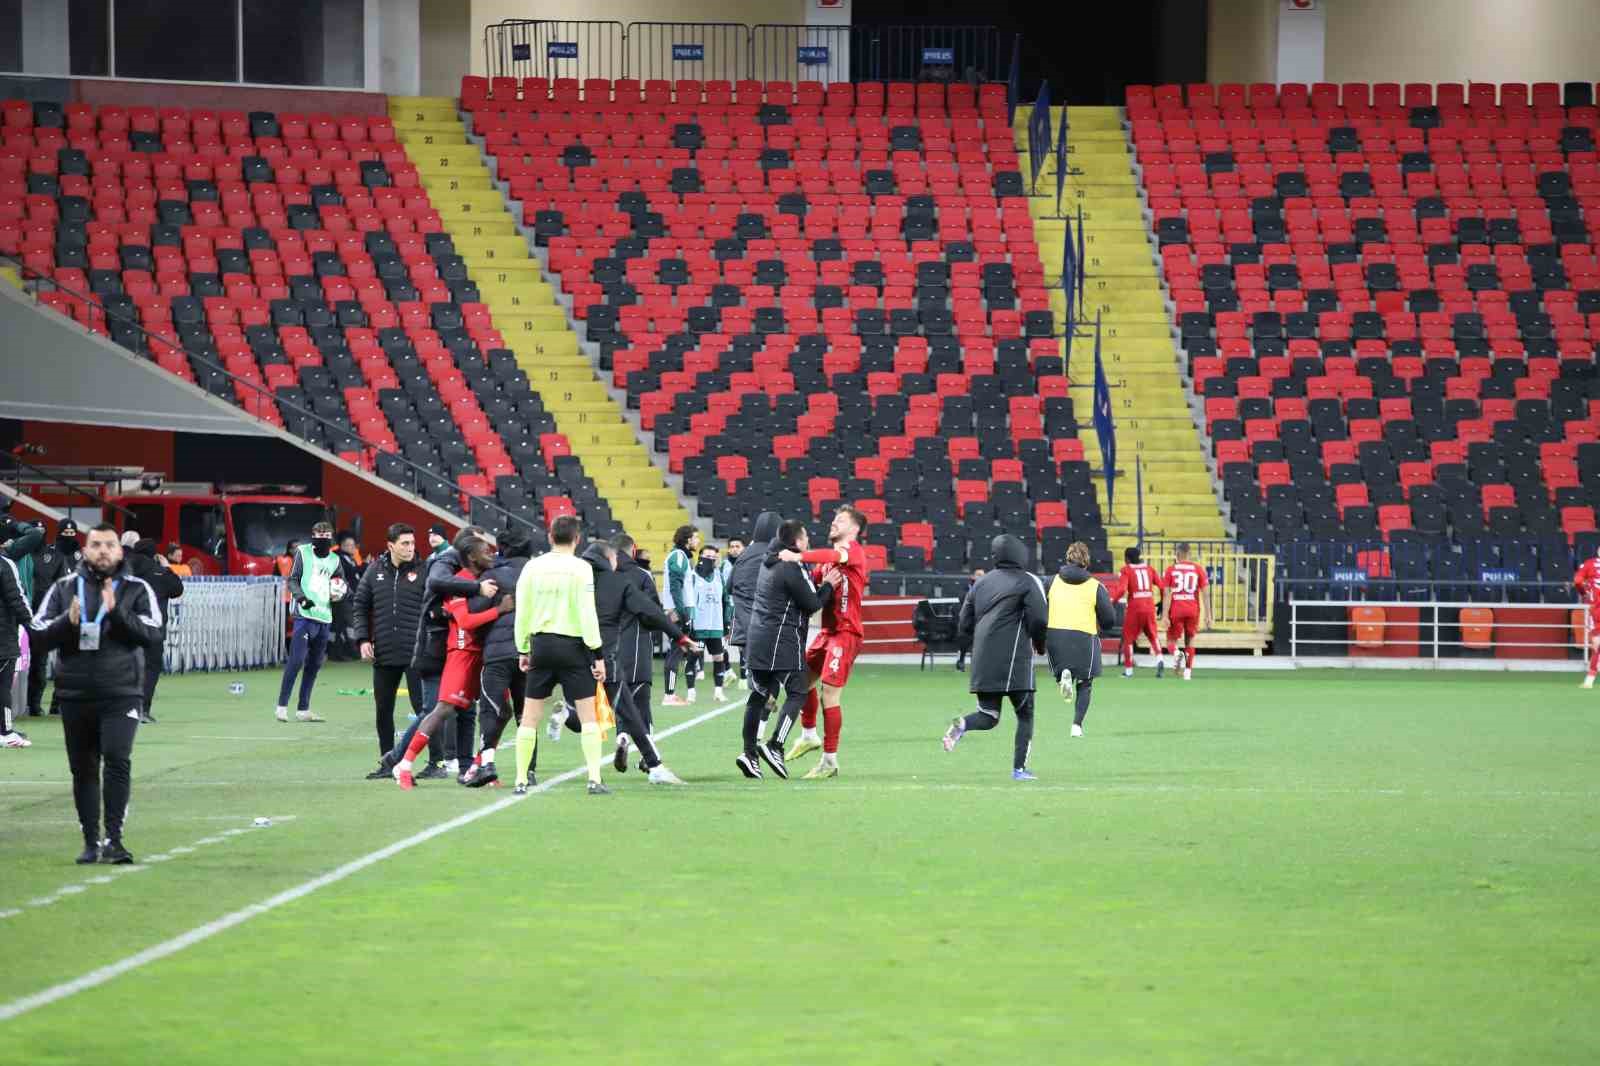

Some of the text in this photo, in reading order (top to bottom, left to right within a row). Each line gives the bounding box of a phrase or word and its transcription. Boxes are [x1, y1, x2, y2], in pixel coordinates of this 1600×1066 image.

[1135, 569, 1149, 591] 11
[1171, 571, 1198, 592] 30
[829, 659, 839, 672] 4
